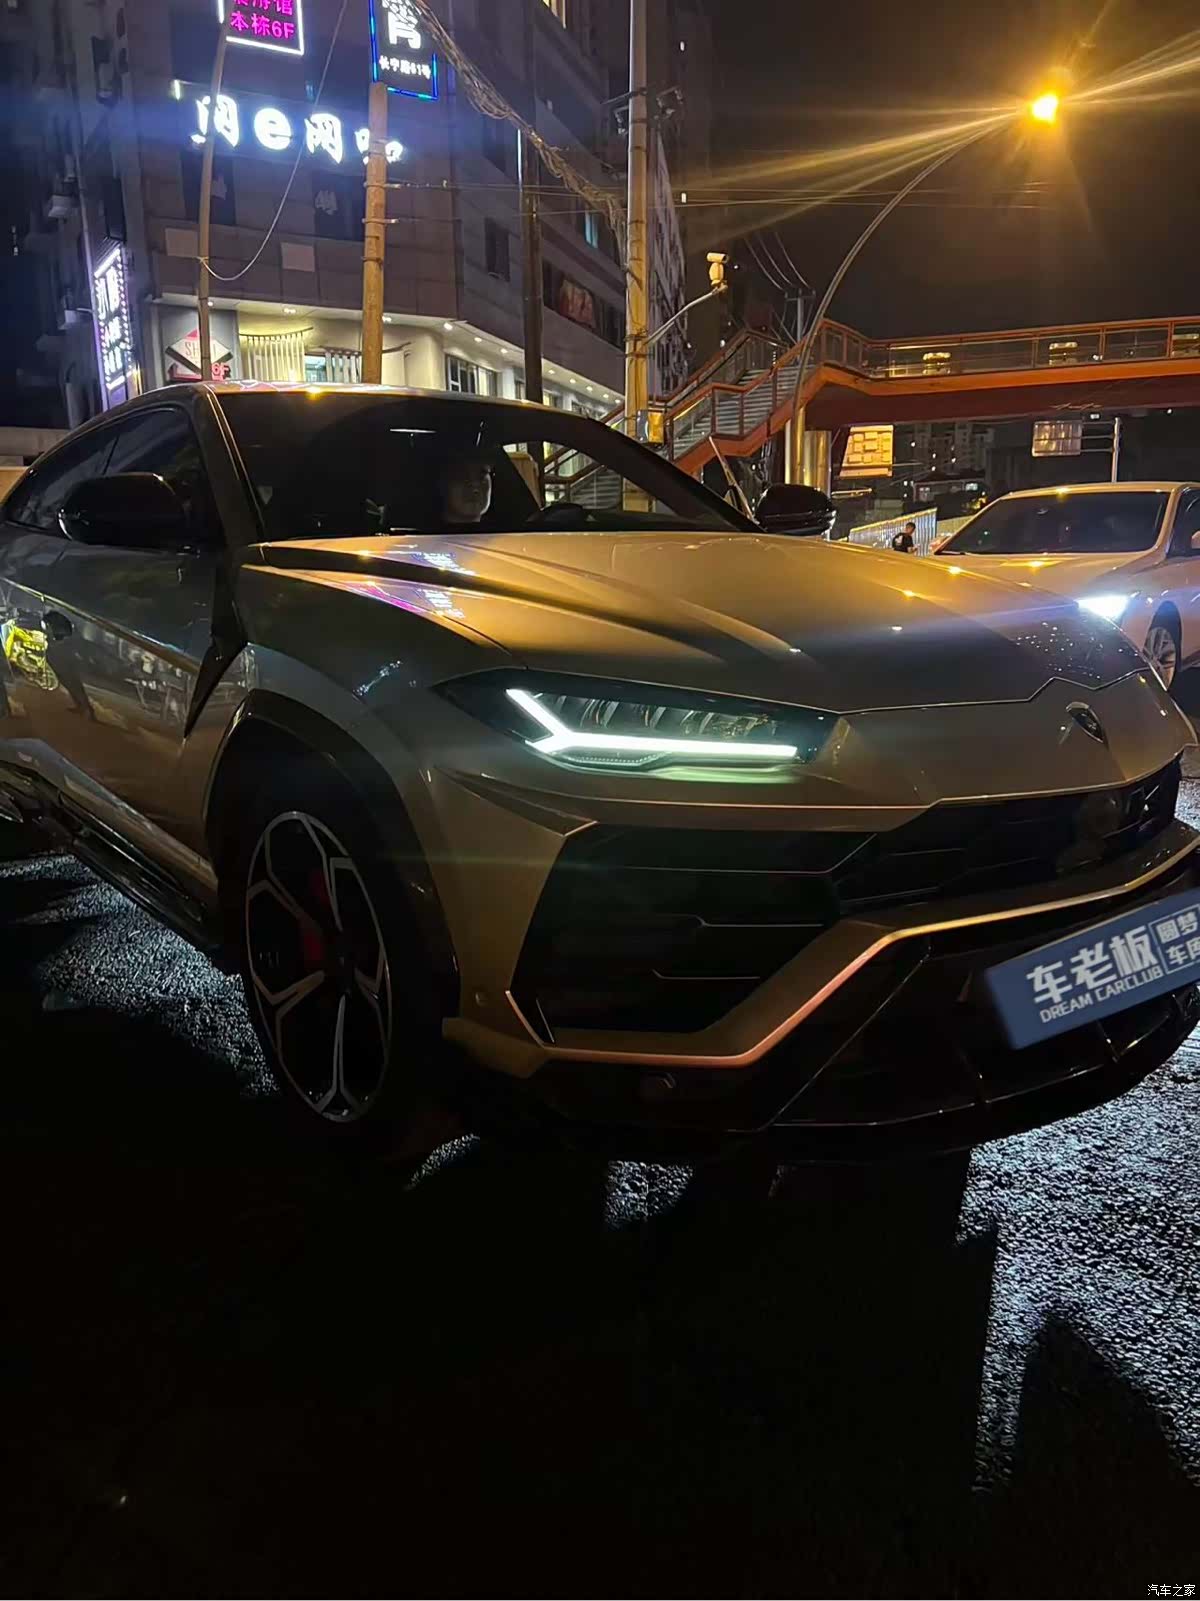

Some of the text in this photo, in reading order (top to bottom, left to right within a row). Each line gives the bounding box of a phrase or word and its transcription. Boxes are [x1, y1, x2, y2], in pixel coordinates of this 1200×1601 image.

[230, 10, 295, 39] 本栋6F
[1156, 911, 1198, 944] 圆梦
[1026, 925, 1159, 1004] 车老板
[1039, 967, 1164, 1023] DREAM CARCLUB
